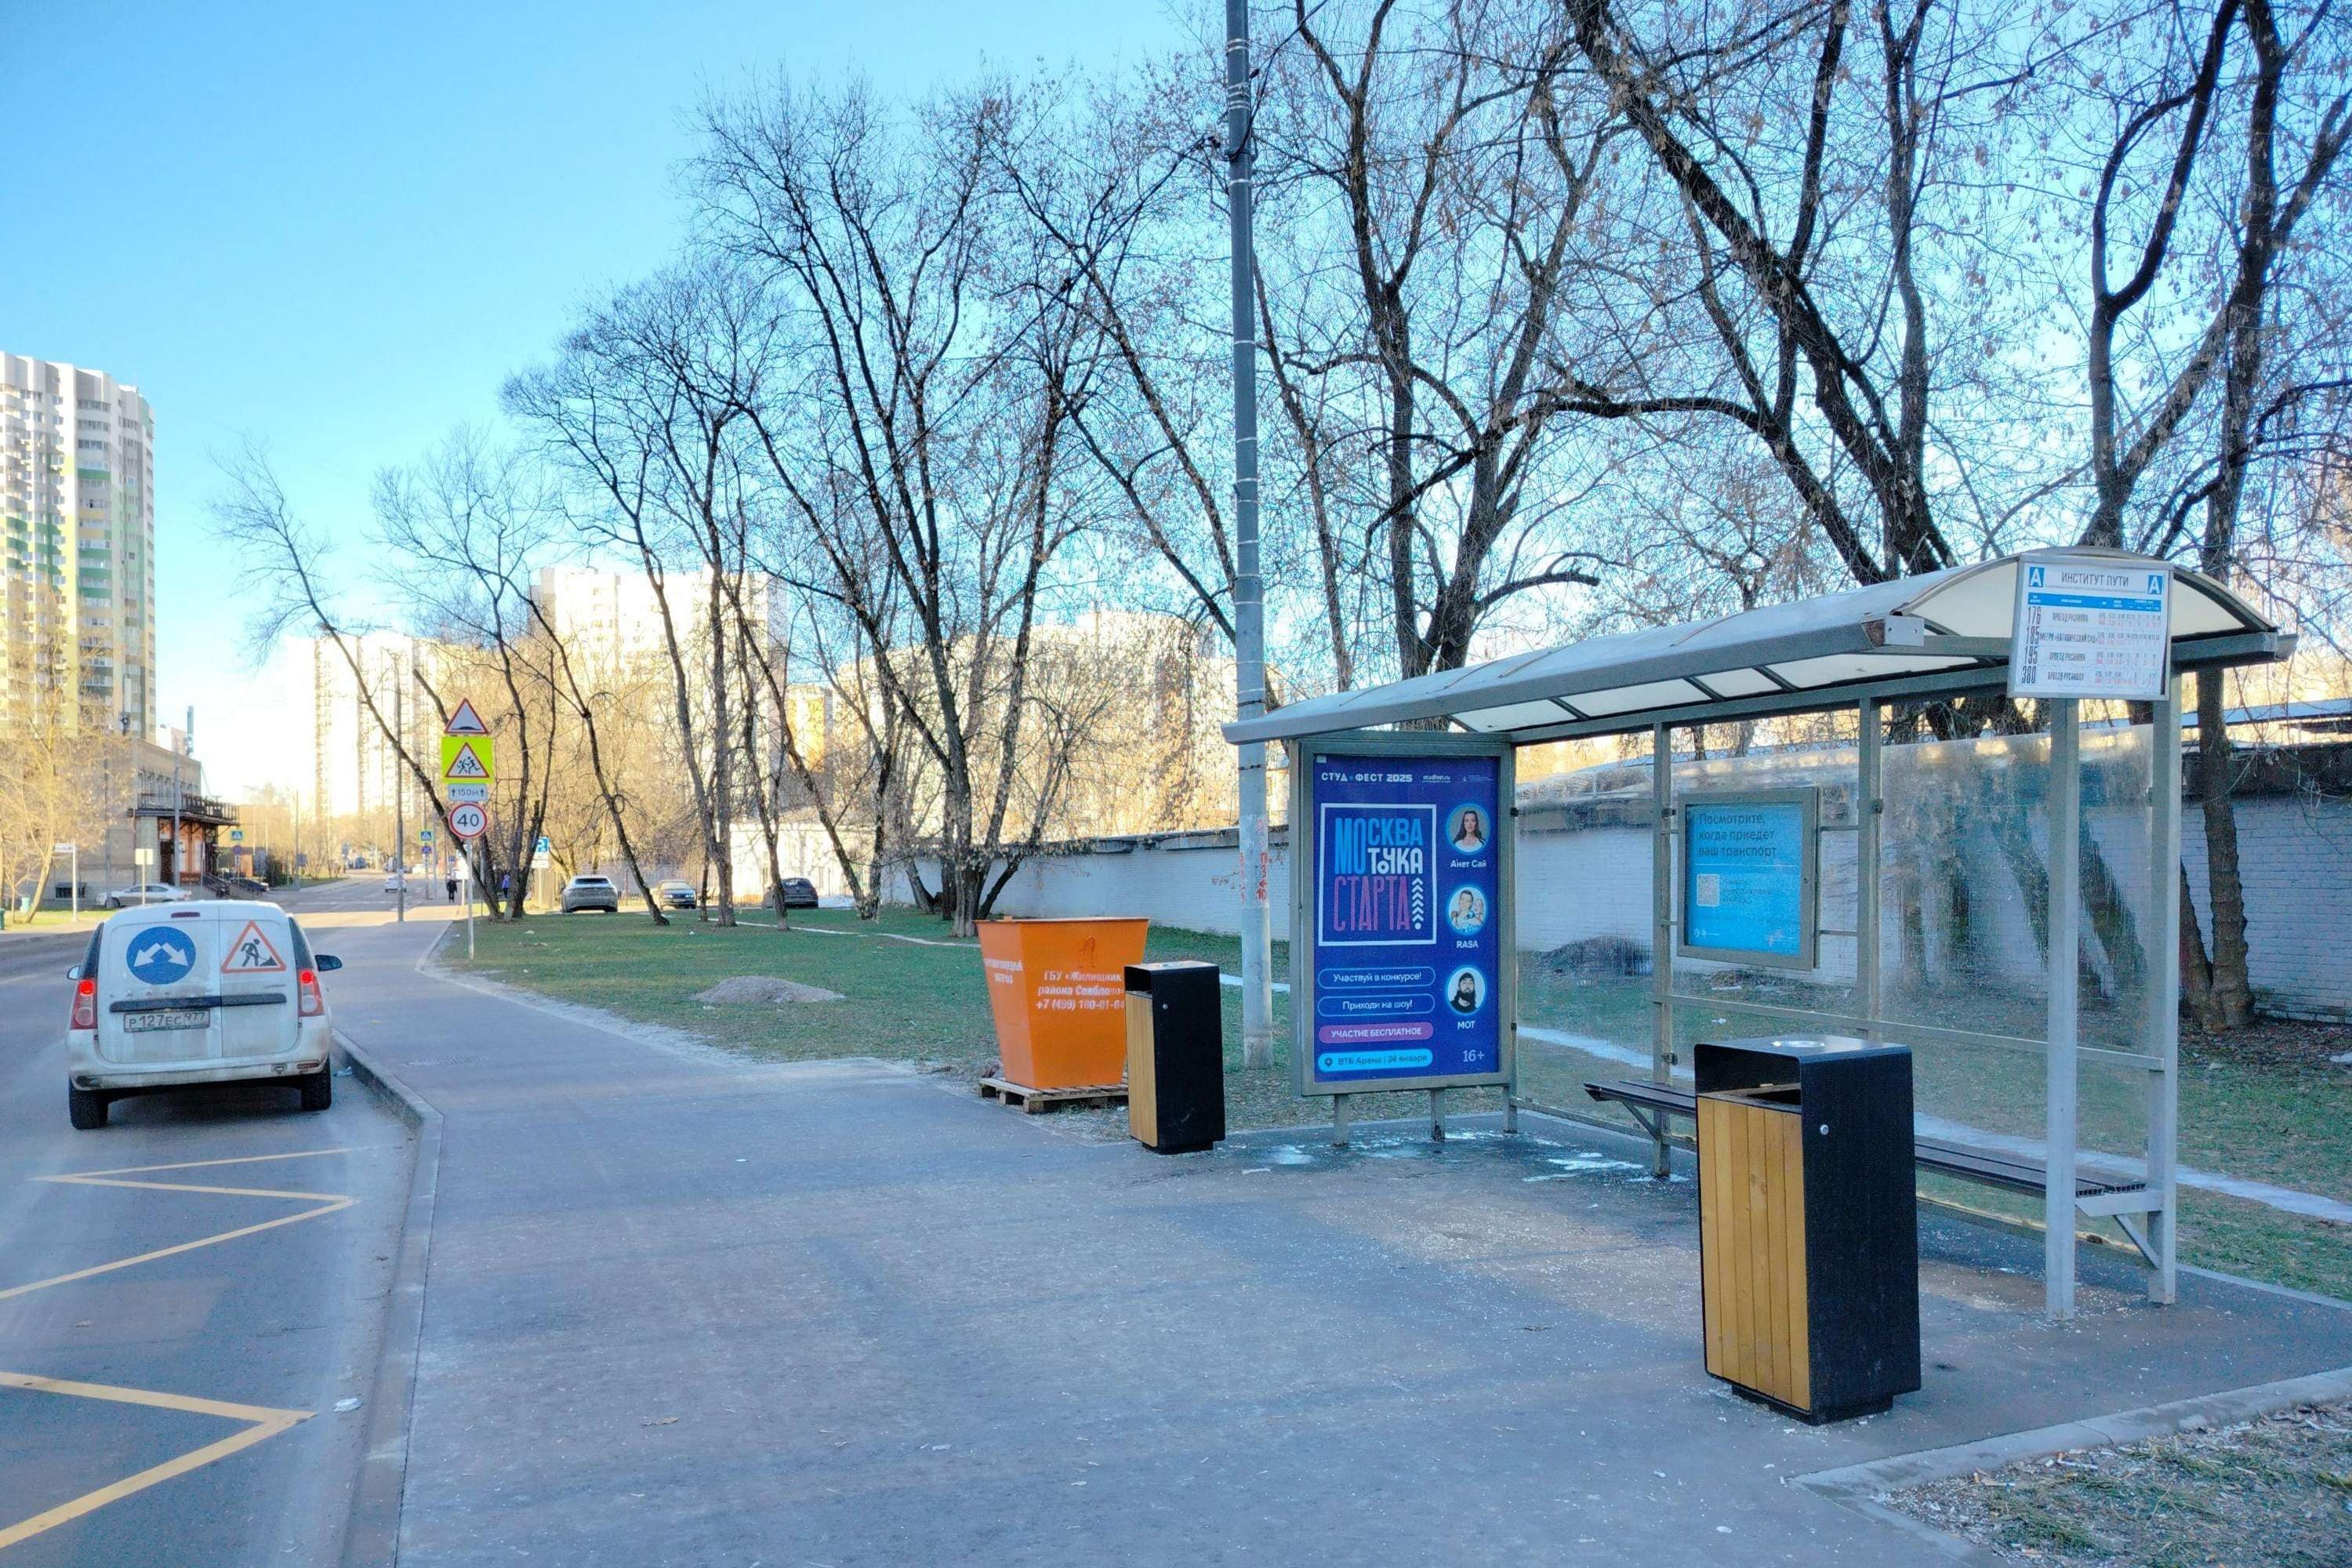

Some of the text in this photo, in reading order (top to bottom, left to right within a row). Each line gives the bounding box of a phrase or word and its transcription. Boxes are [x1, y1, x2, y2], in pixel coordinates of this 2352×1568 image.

[2061, 572, 2129, 587] ИНСТИТУТ ПУТИ
[2027, 606, 2042, 625] 176
[2026, 626, 2040, 644] 185
[2024, 646, 2038, 664] 195
[2022, 666, 2037, 684] 380
[1321, 772, 1413, 782] СТУД ФЕСТ 2025
[457, 814, 479, 827] 40
[1699, 813, 1765, 826] Посмотрите,
[1699, 830, 1775, 842] когда приедет
[1334, 818, 1423, 874] МОСКВА
[1699, 847, 1777, 858] ваш транспорт
[1472, 859, 1487, 868] Сай
[1334, 875, 1410, 931] СТАРТА
[1456, 940, 1479, 949] RASA
[1044, 971, 1062, 981] ГБУ
[1333, 973, 1373, 983] Участвуй
[1381, 972, 1421, 982] конкурсе!
[1037, 986, 1073, 996] района
[1036, 999, 1050, 1009] +7
[1342, 1001, 1380, 1011] Приходи
[1394, 1000, 1413, 1010] шоу!
[184, 1012, 205, 1022] 977
[1331, 1027, 1422, 1038] УЧАСТИЕ БЕСПЛАТНОЕ
[1356, 1057, 1381, 1066] Арена
[1399, 1055, 1427, 1065] января
[1463, 1049, 1485, 1062] 16+
